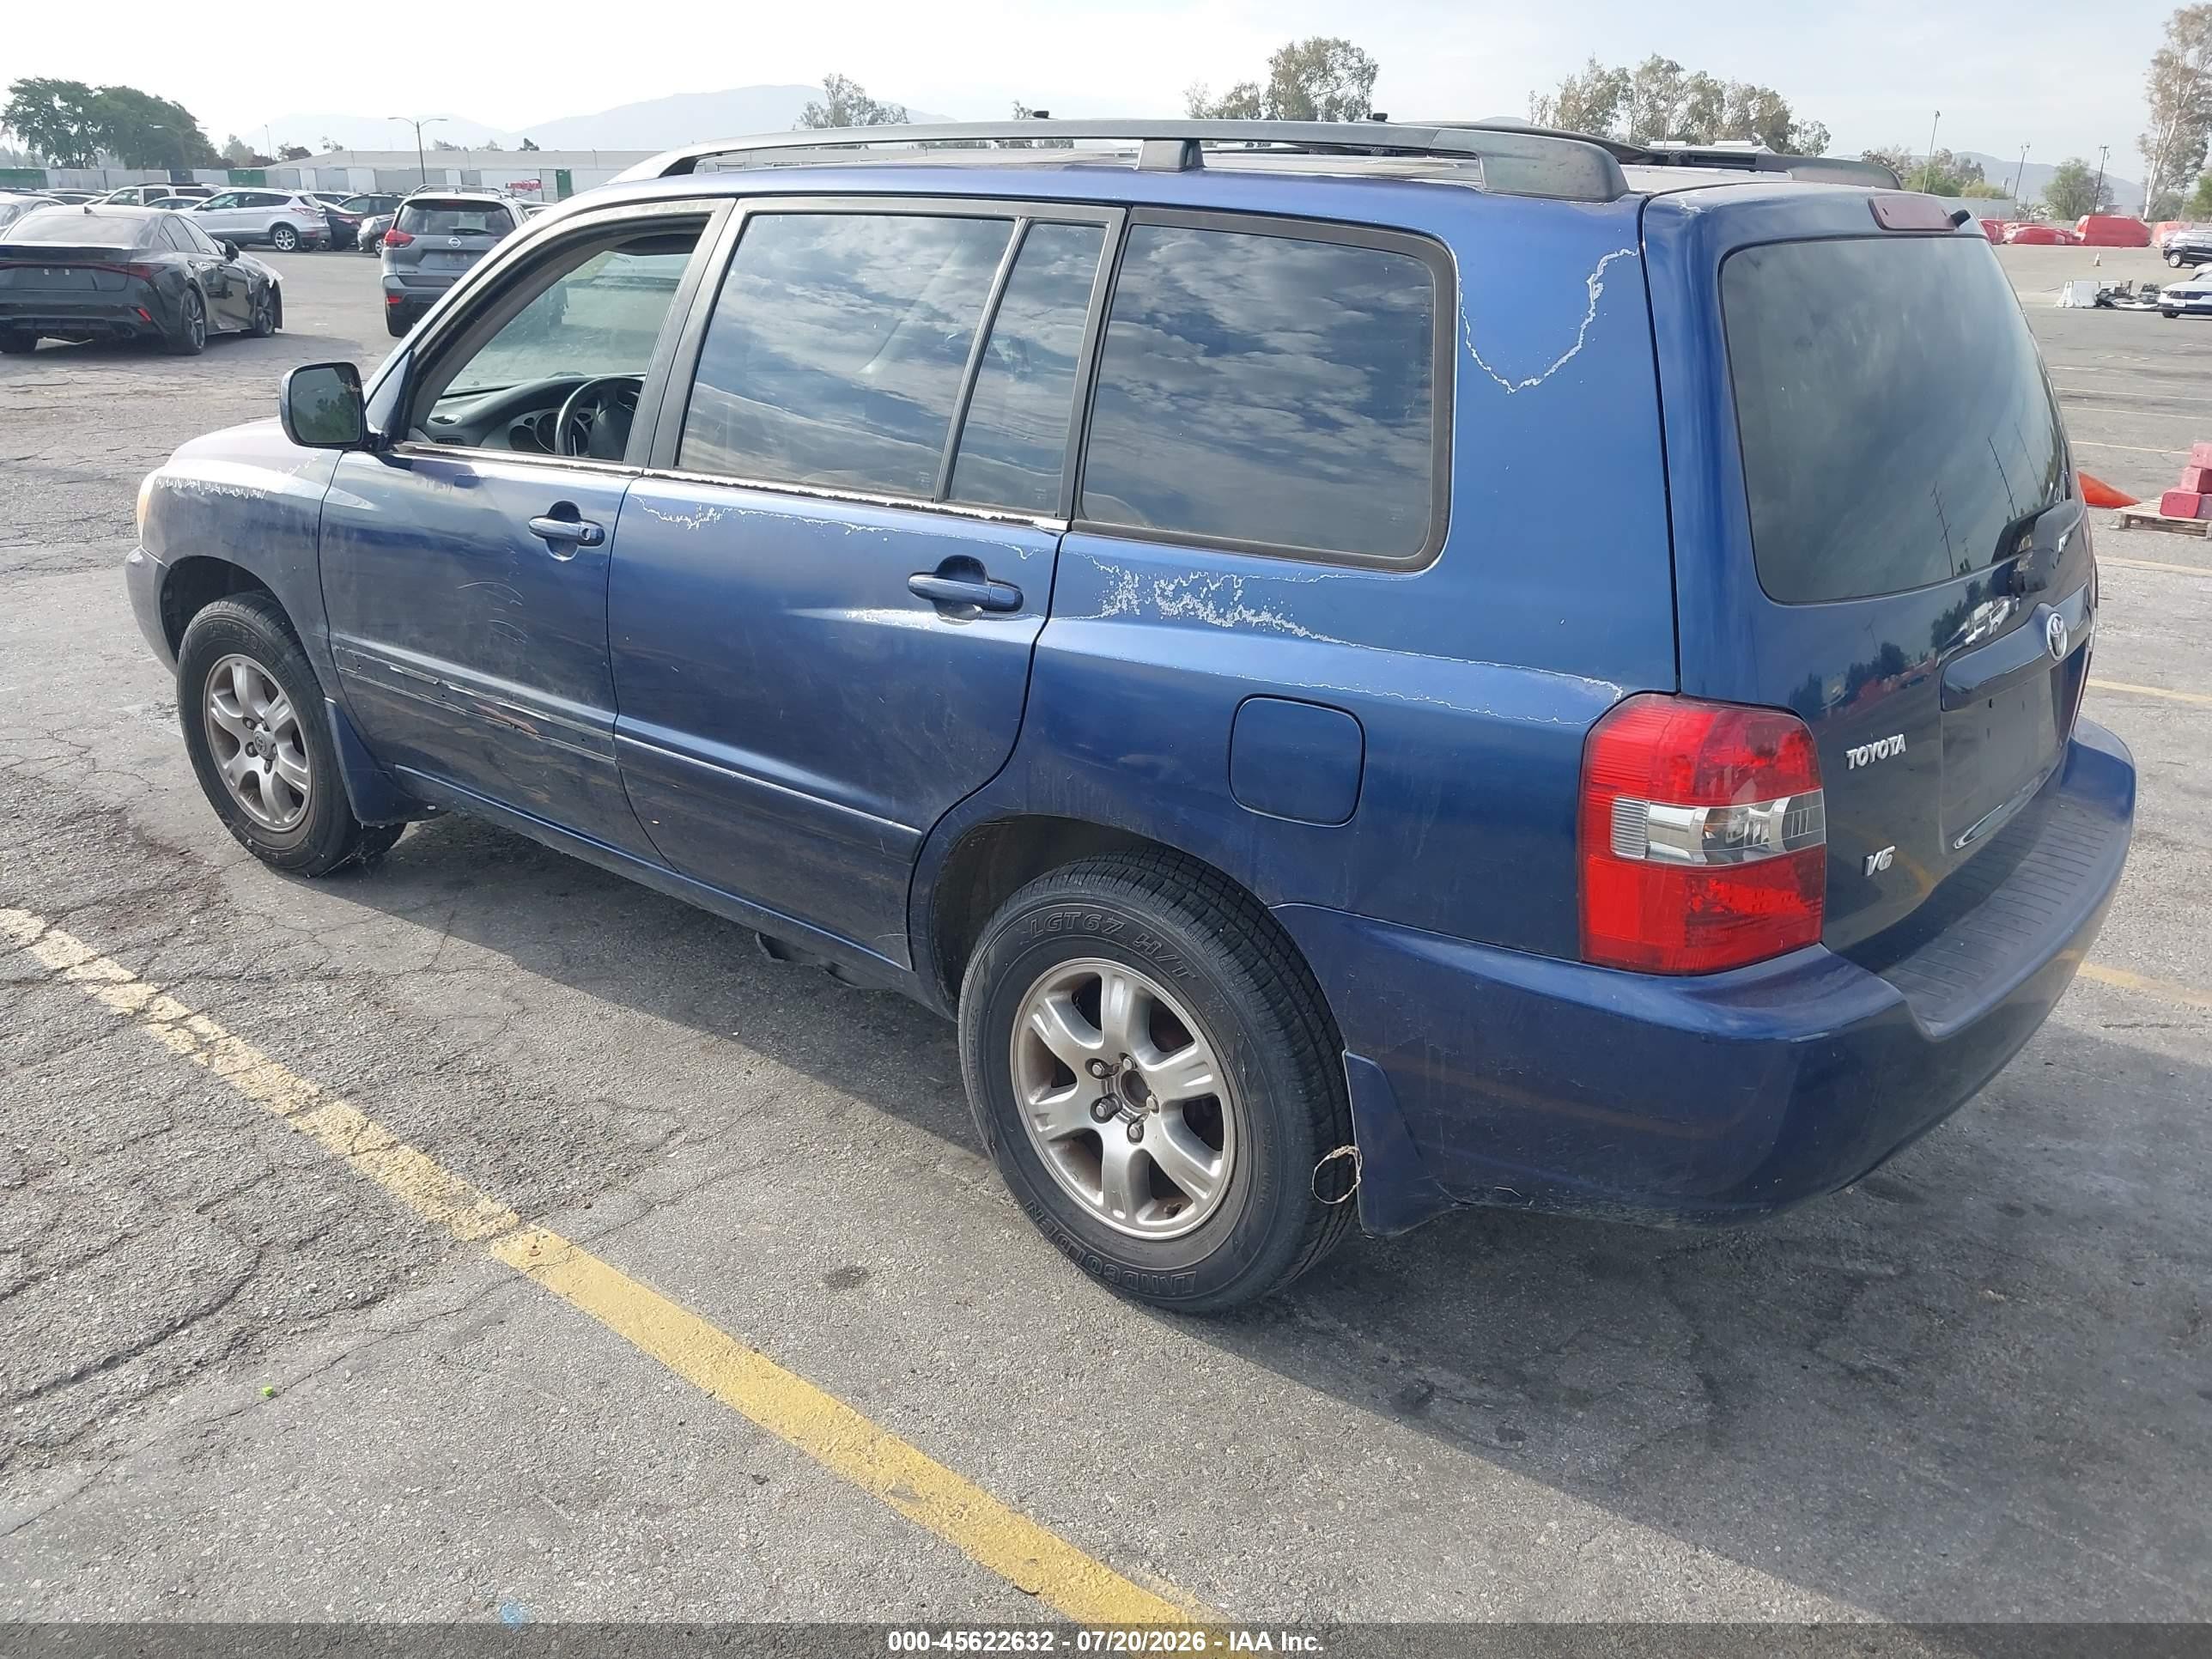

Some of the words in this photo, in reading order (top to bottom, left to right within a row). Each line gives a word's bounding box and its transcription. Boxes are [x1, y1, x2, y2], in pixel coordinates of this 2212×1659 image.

[1844, 733, 1907, 770] TOYOTA
[1865, 845, 1896, 877] V6
[1133, 933, 1199, 979] H/T
